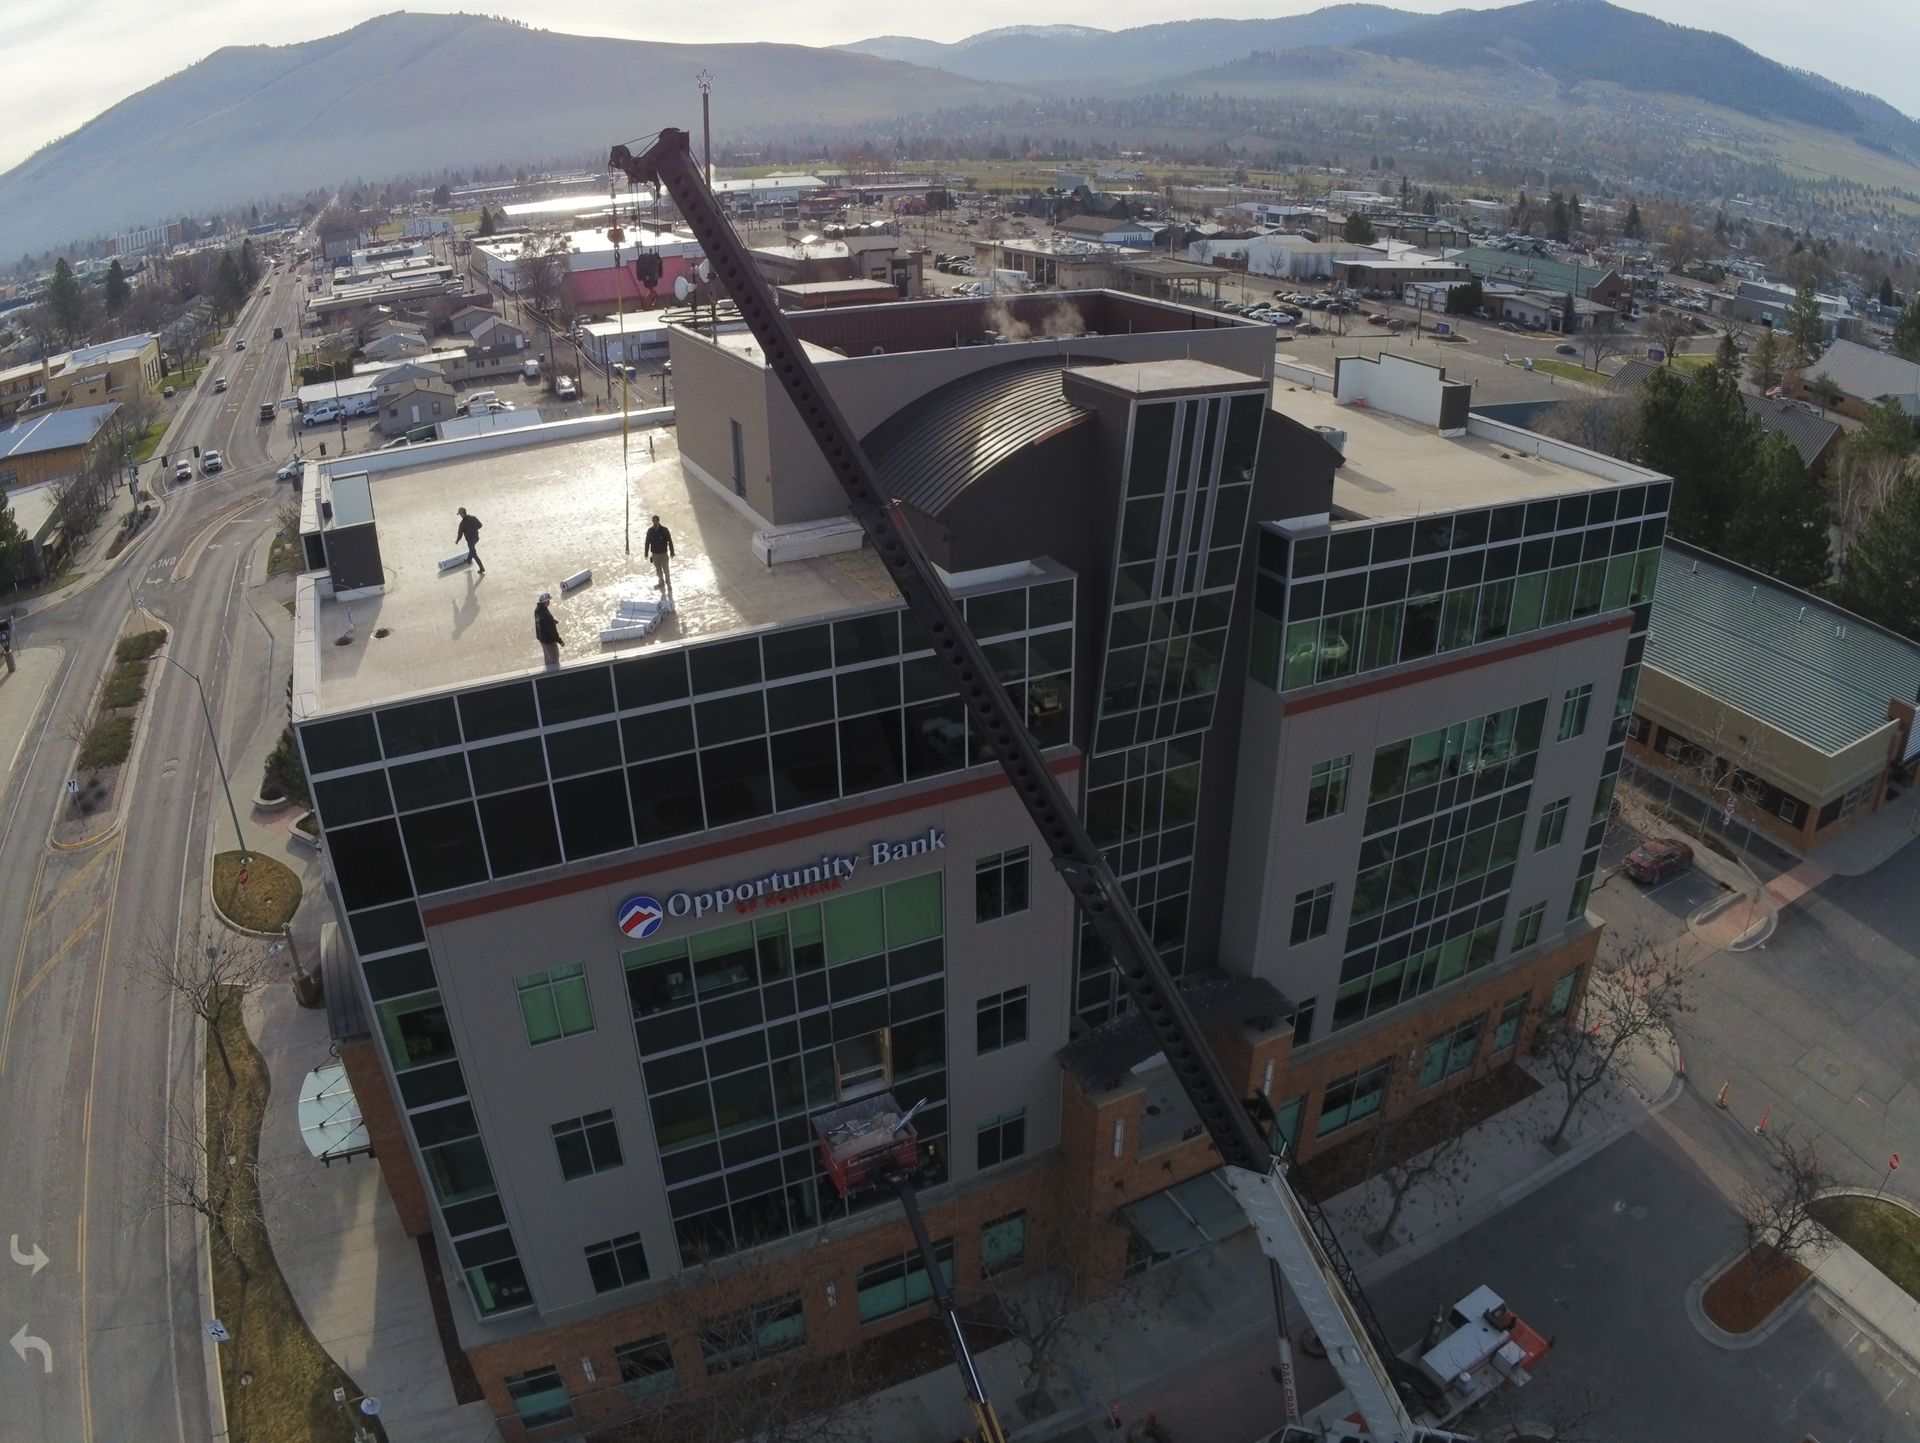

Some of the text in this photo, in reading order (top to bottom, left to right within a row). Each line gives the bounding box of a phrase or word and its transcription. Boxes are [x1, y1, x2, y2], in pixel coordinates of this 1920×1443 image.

[150, 556, 177, 570] ONLY
[667, 828, 947, 919] Opportunity Bank
[1284, 1388, 1297, 1421] CRANE
